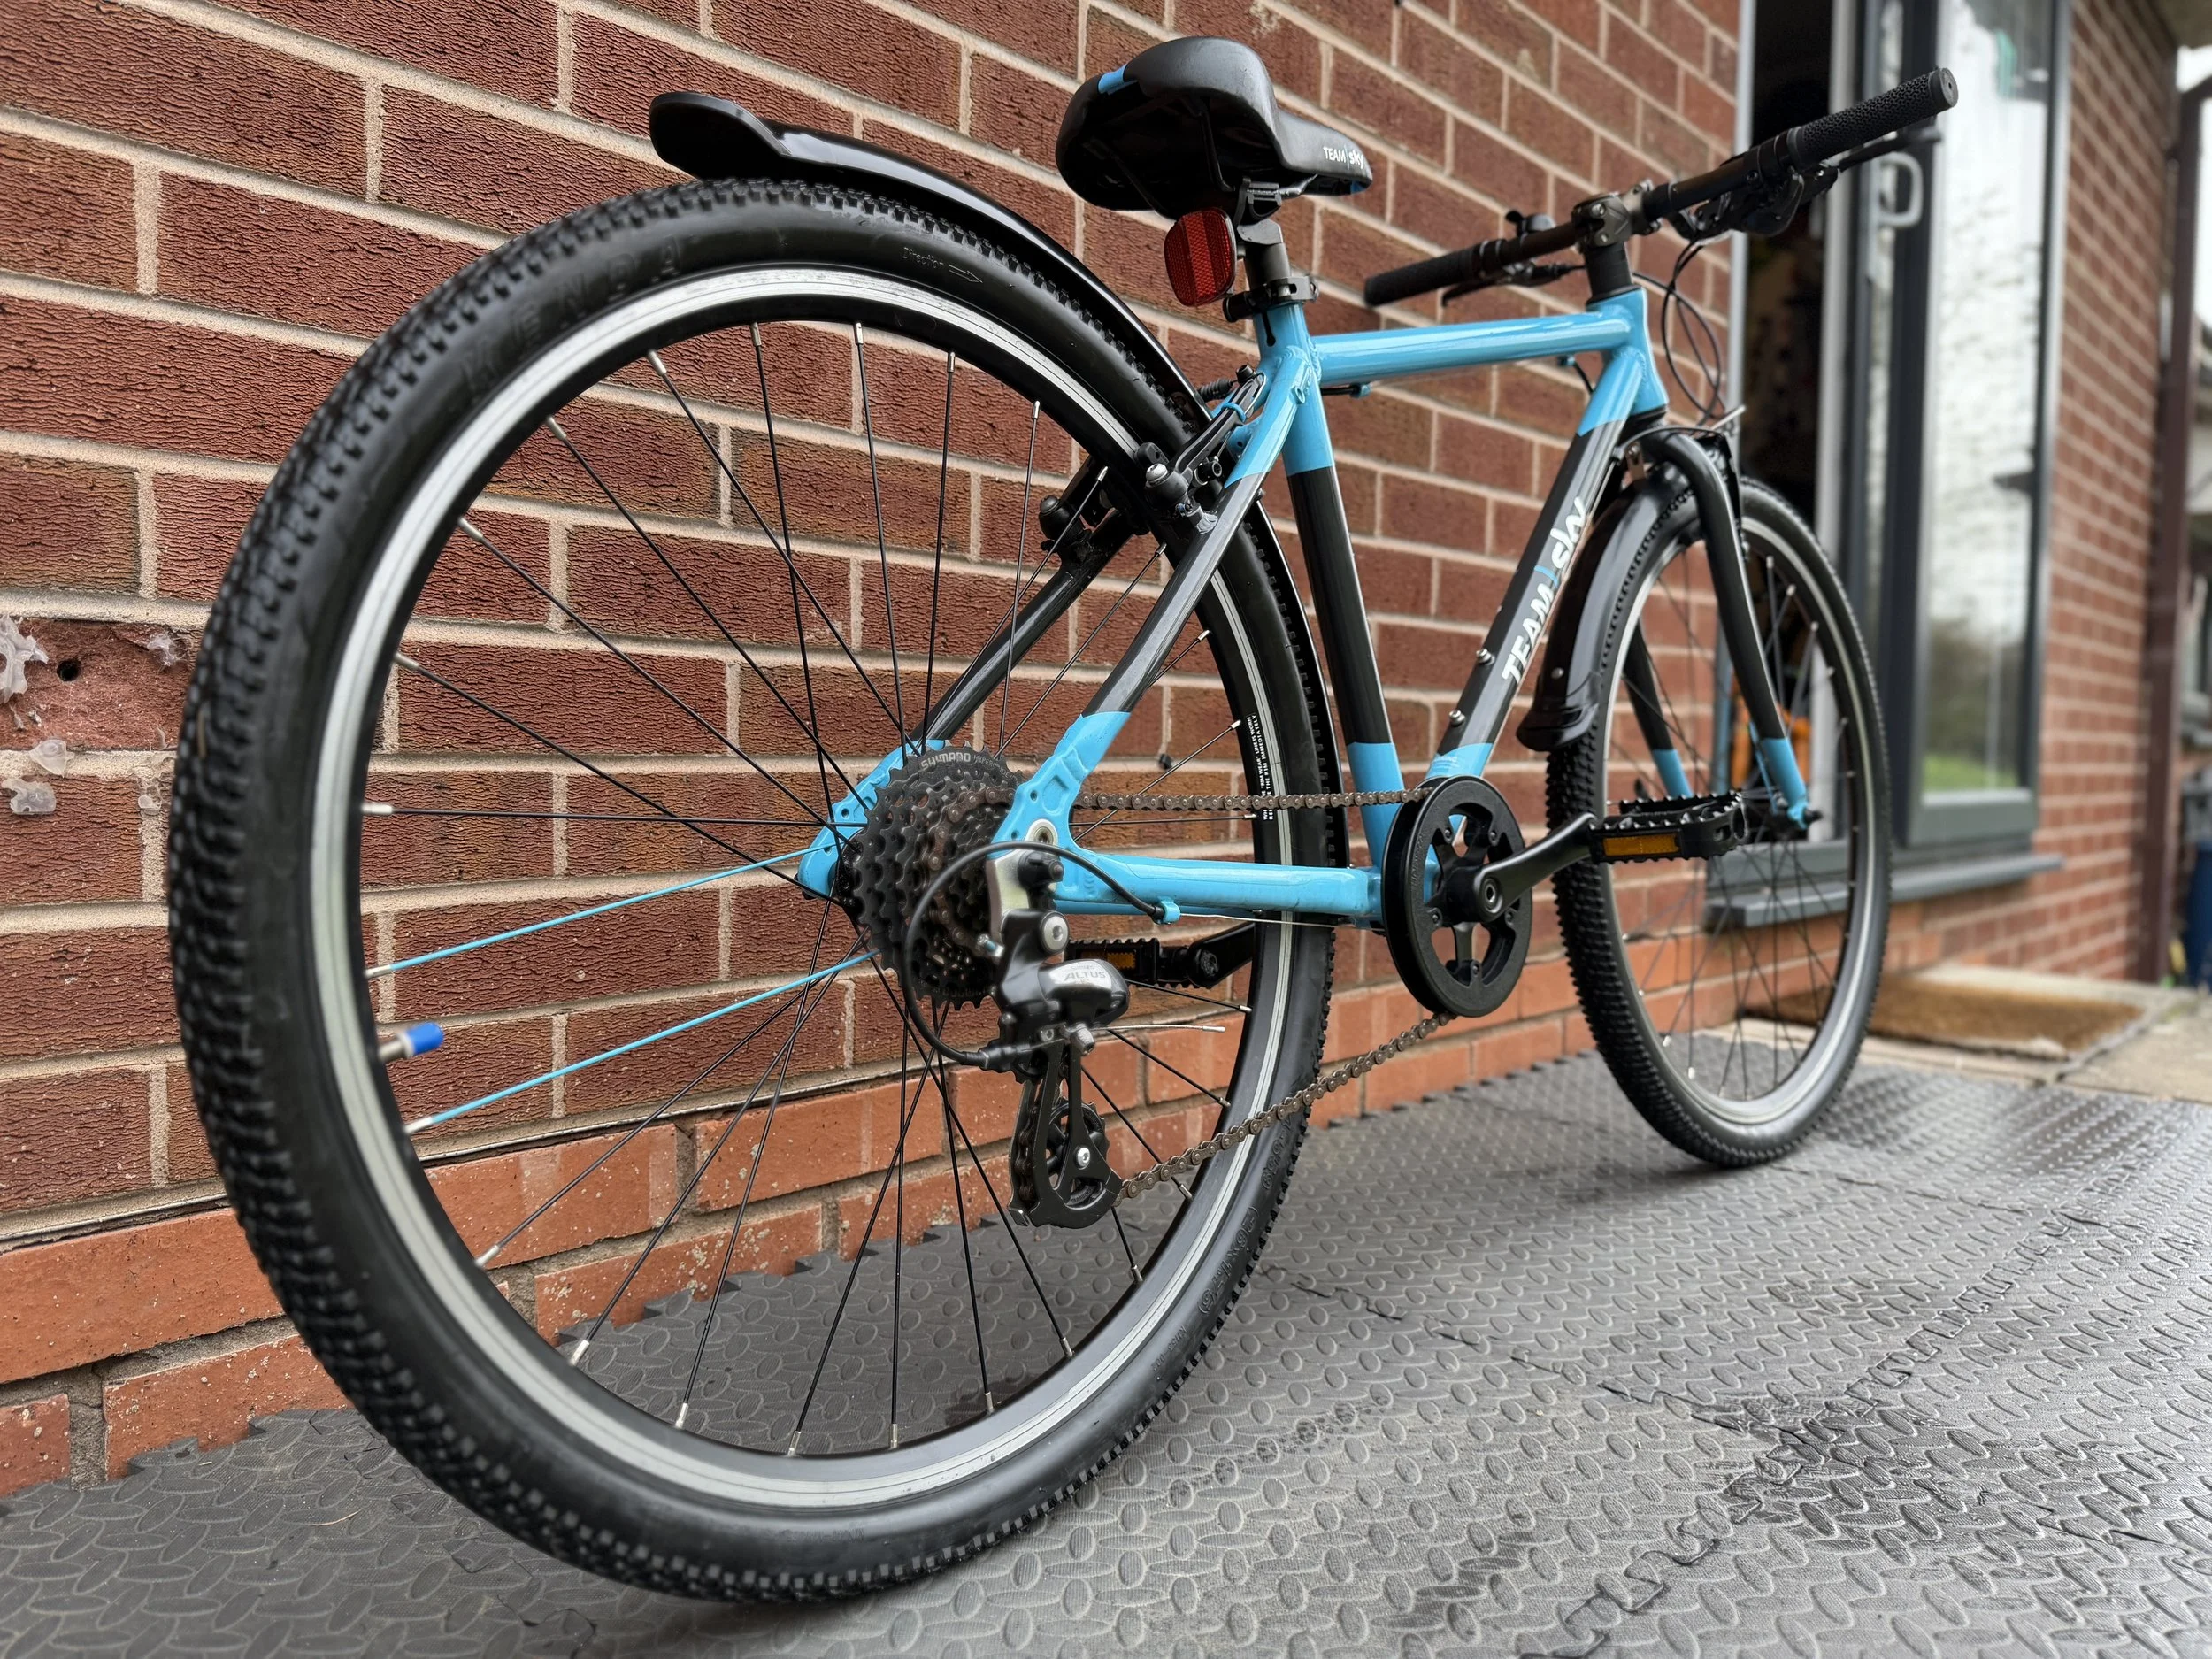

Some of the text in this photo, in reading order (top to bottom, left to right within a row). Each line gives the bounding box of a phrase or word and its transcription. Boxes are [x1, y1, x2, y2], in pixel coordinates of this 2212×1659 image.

[1323, 146, 1363, 169] TEAM sky
[901, 247, 945, 269] Direction
[1502, 496, 1586, 684] TEAM sky
[1251, 715, 1266, 760] IMMEDIATELY
[921, 752, 971, 770] SHIMANO
[1064, 971, 1106, 981] ALTUS
